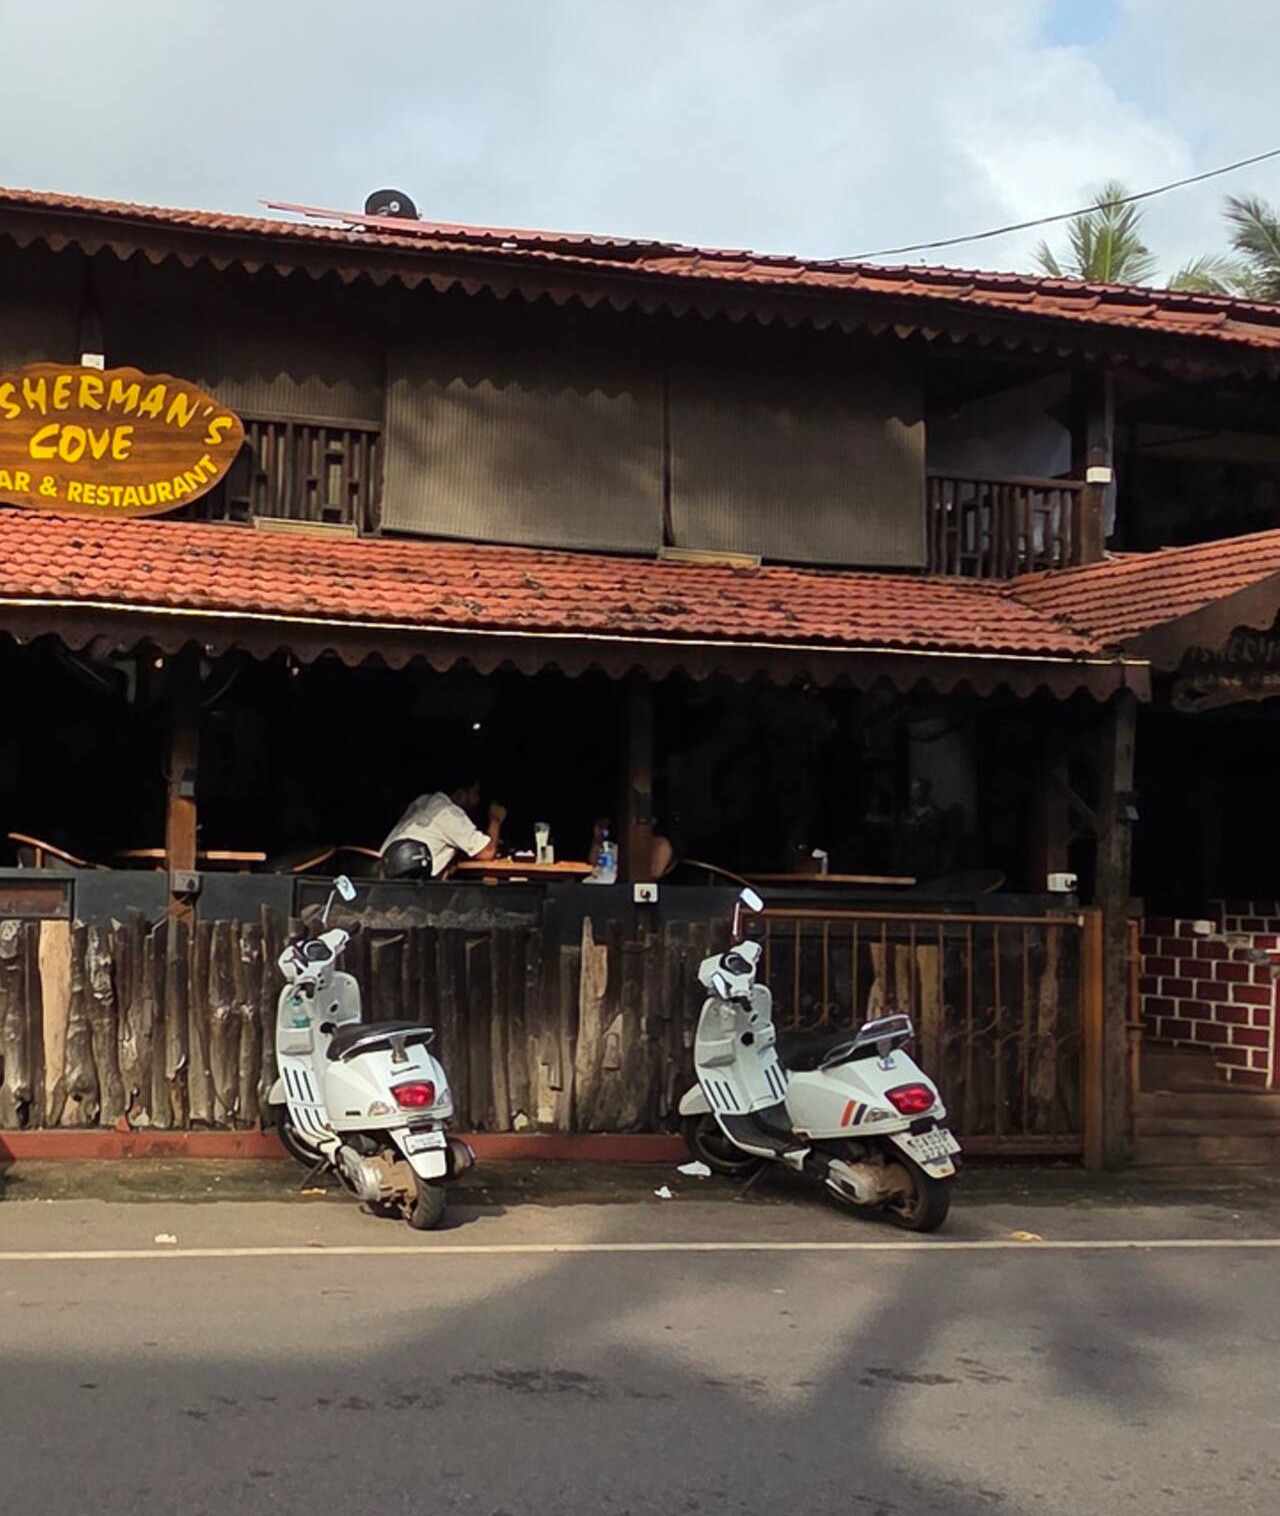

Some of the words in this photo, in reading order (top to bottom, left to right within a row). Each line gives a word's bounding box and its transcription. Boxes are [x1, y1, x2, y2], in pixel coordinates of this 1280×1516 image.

[29, 422, 135, 464] COVE
[39, 475, 58, 498] &
[67, 453, 219, 507] RESTAURANT
